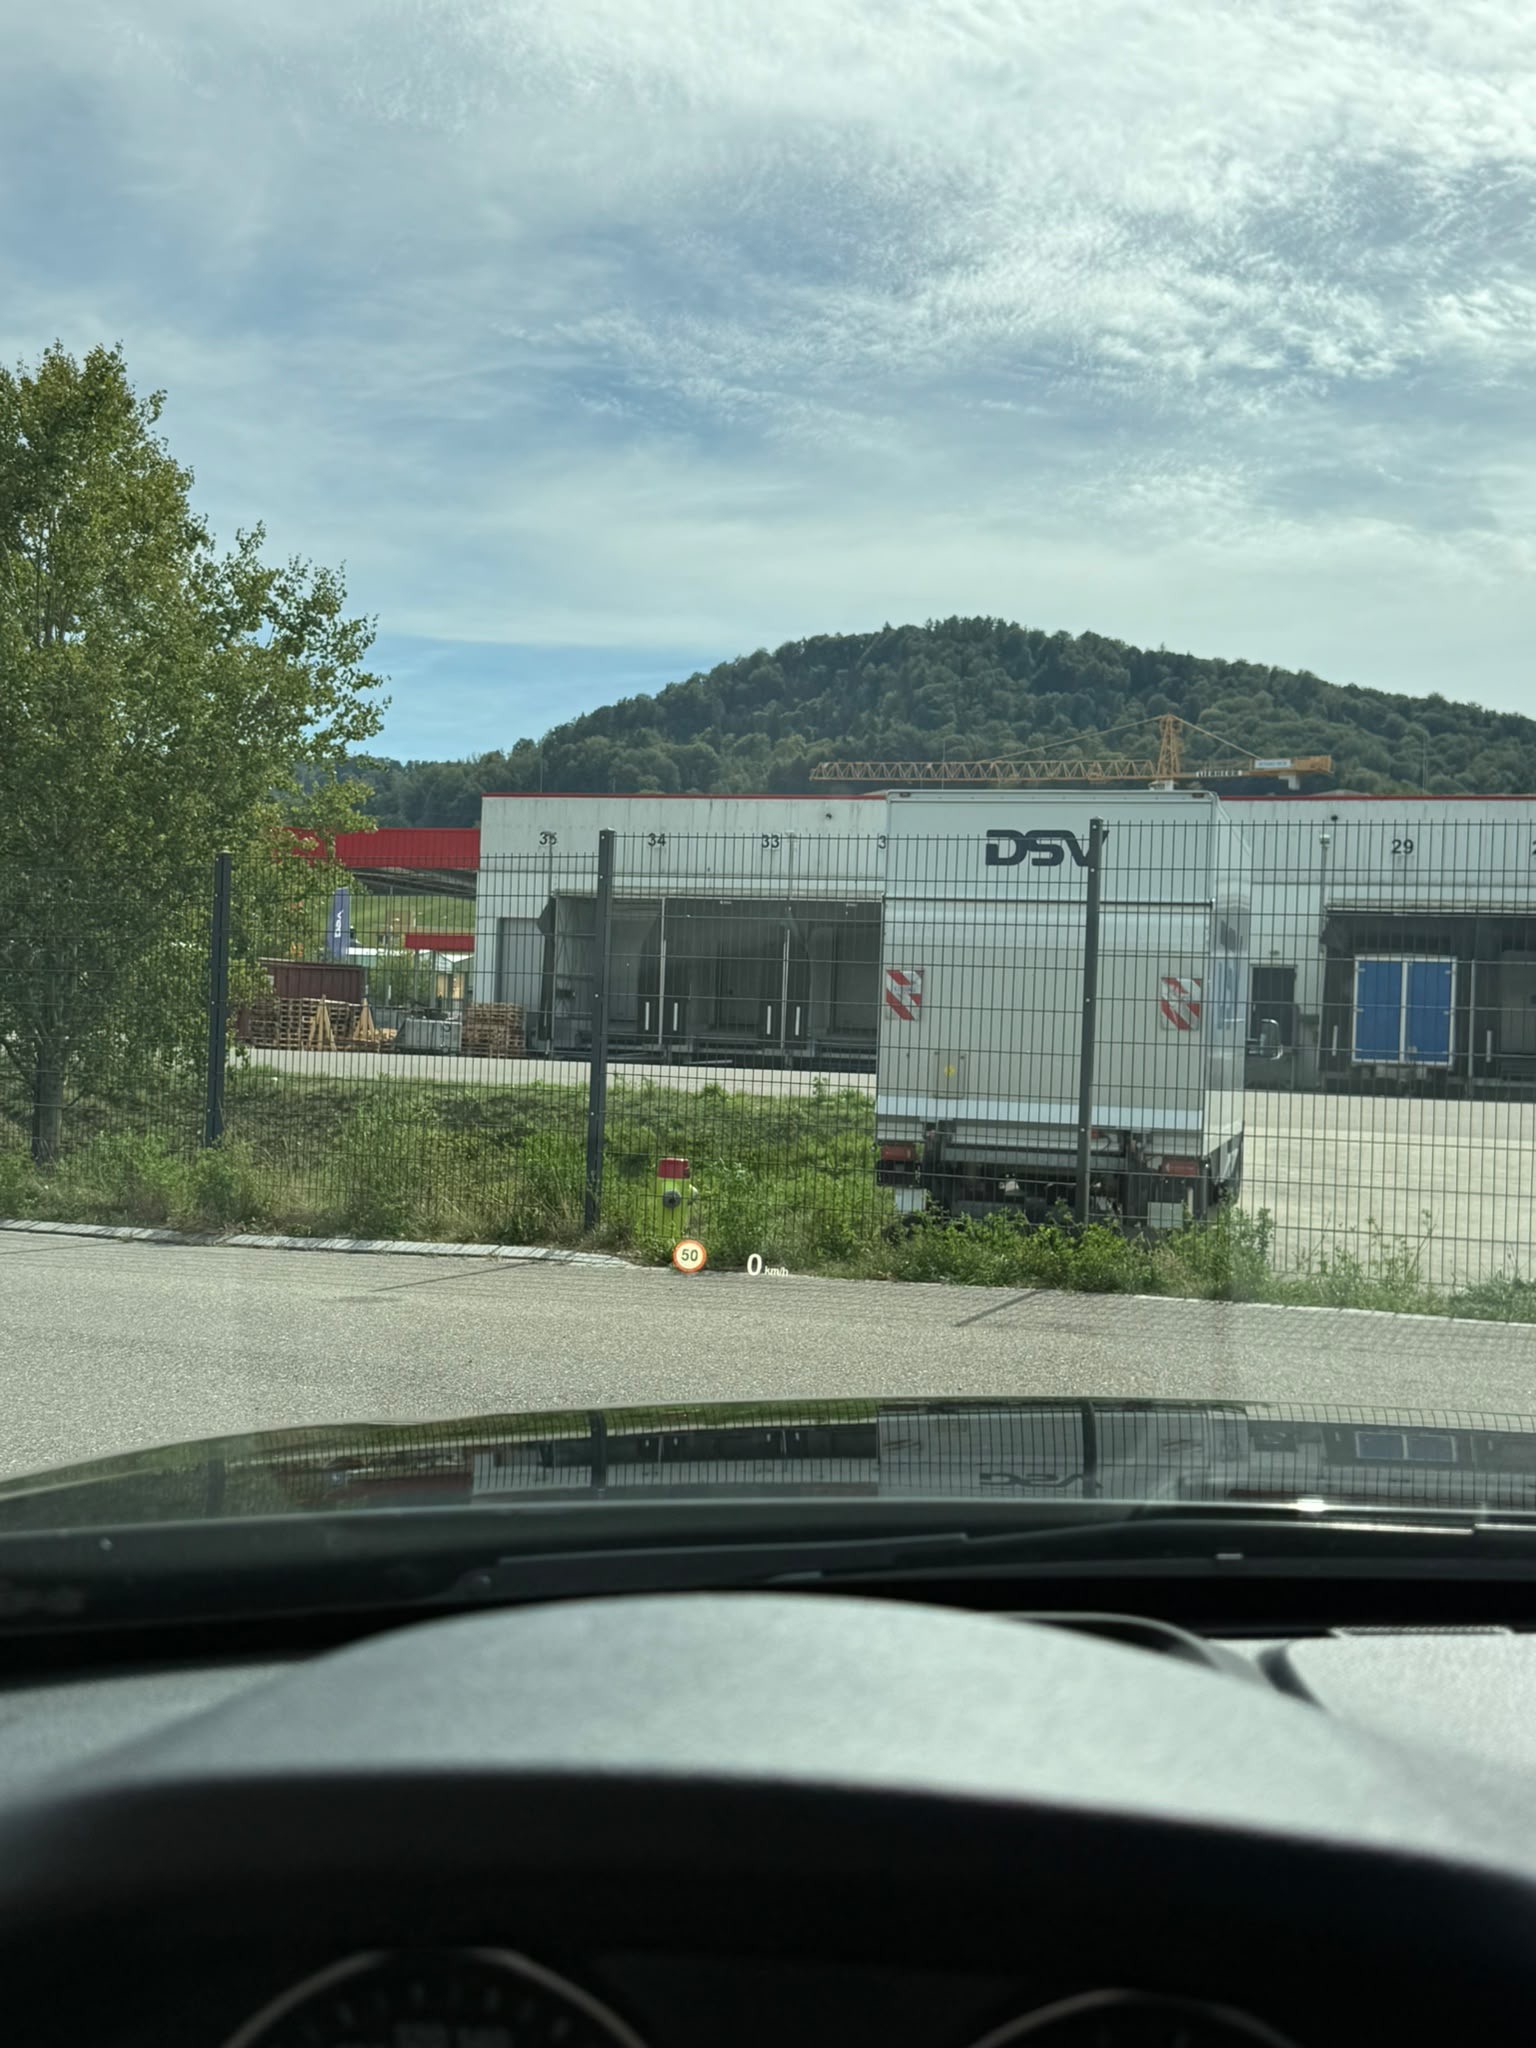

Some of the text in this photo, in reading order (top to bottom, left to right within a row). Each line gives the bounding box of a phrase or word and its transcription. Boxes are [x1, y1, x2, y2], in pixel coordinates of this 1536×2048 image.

[647, 833, 666, 846] 34
[762, 835, 779, 848] 33
[878, 835, 886, 849] 3
[1392, 839, 1413, 854] 29
[985, 829, 1109, 867] DSV
[681, 1248, 698, 1262] 50
[747, 1253, 789, 1277] 0 km/h
